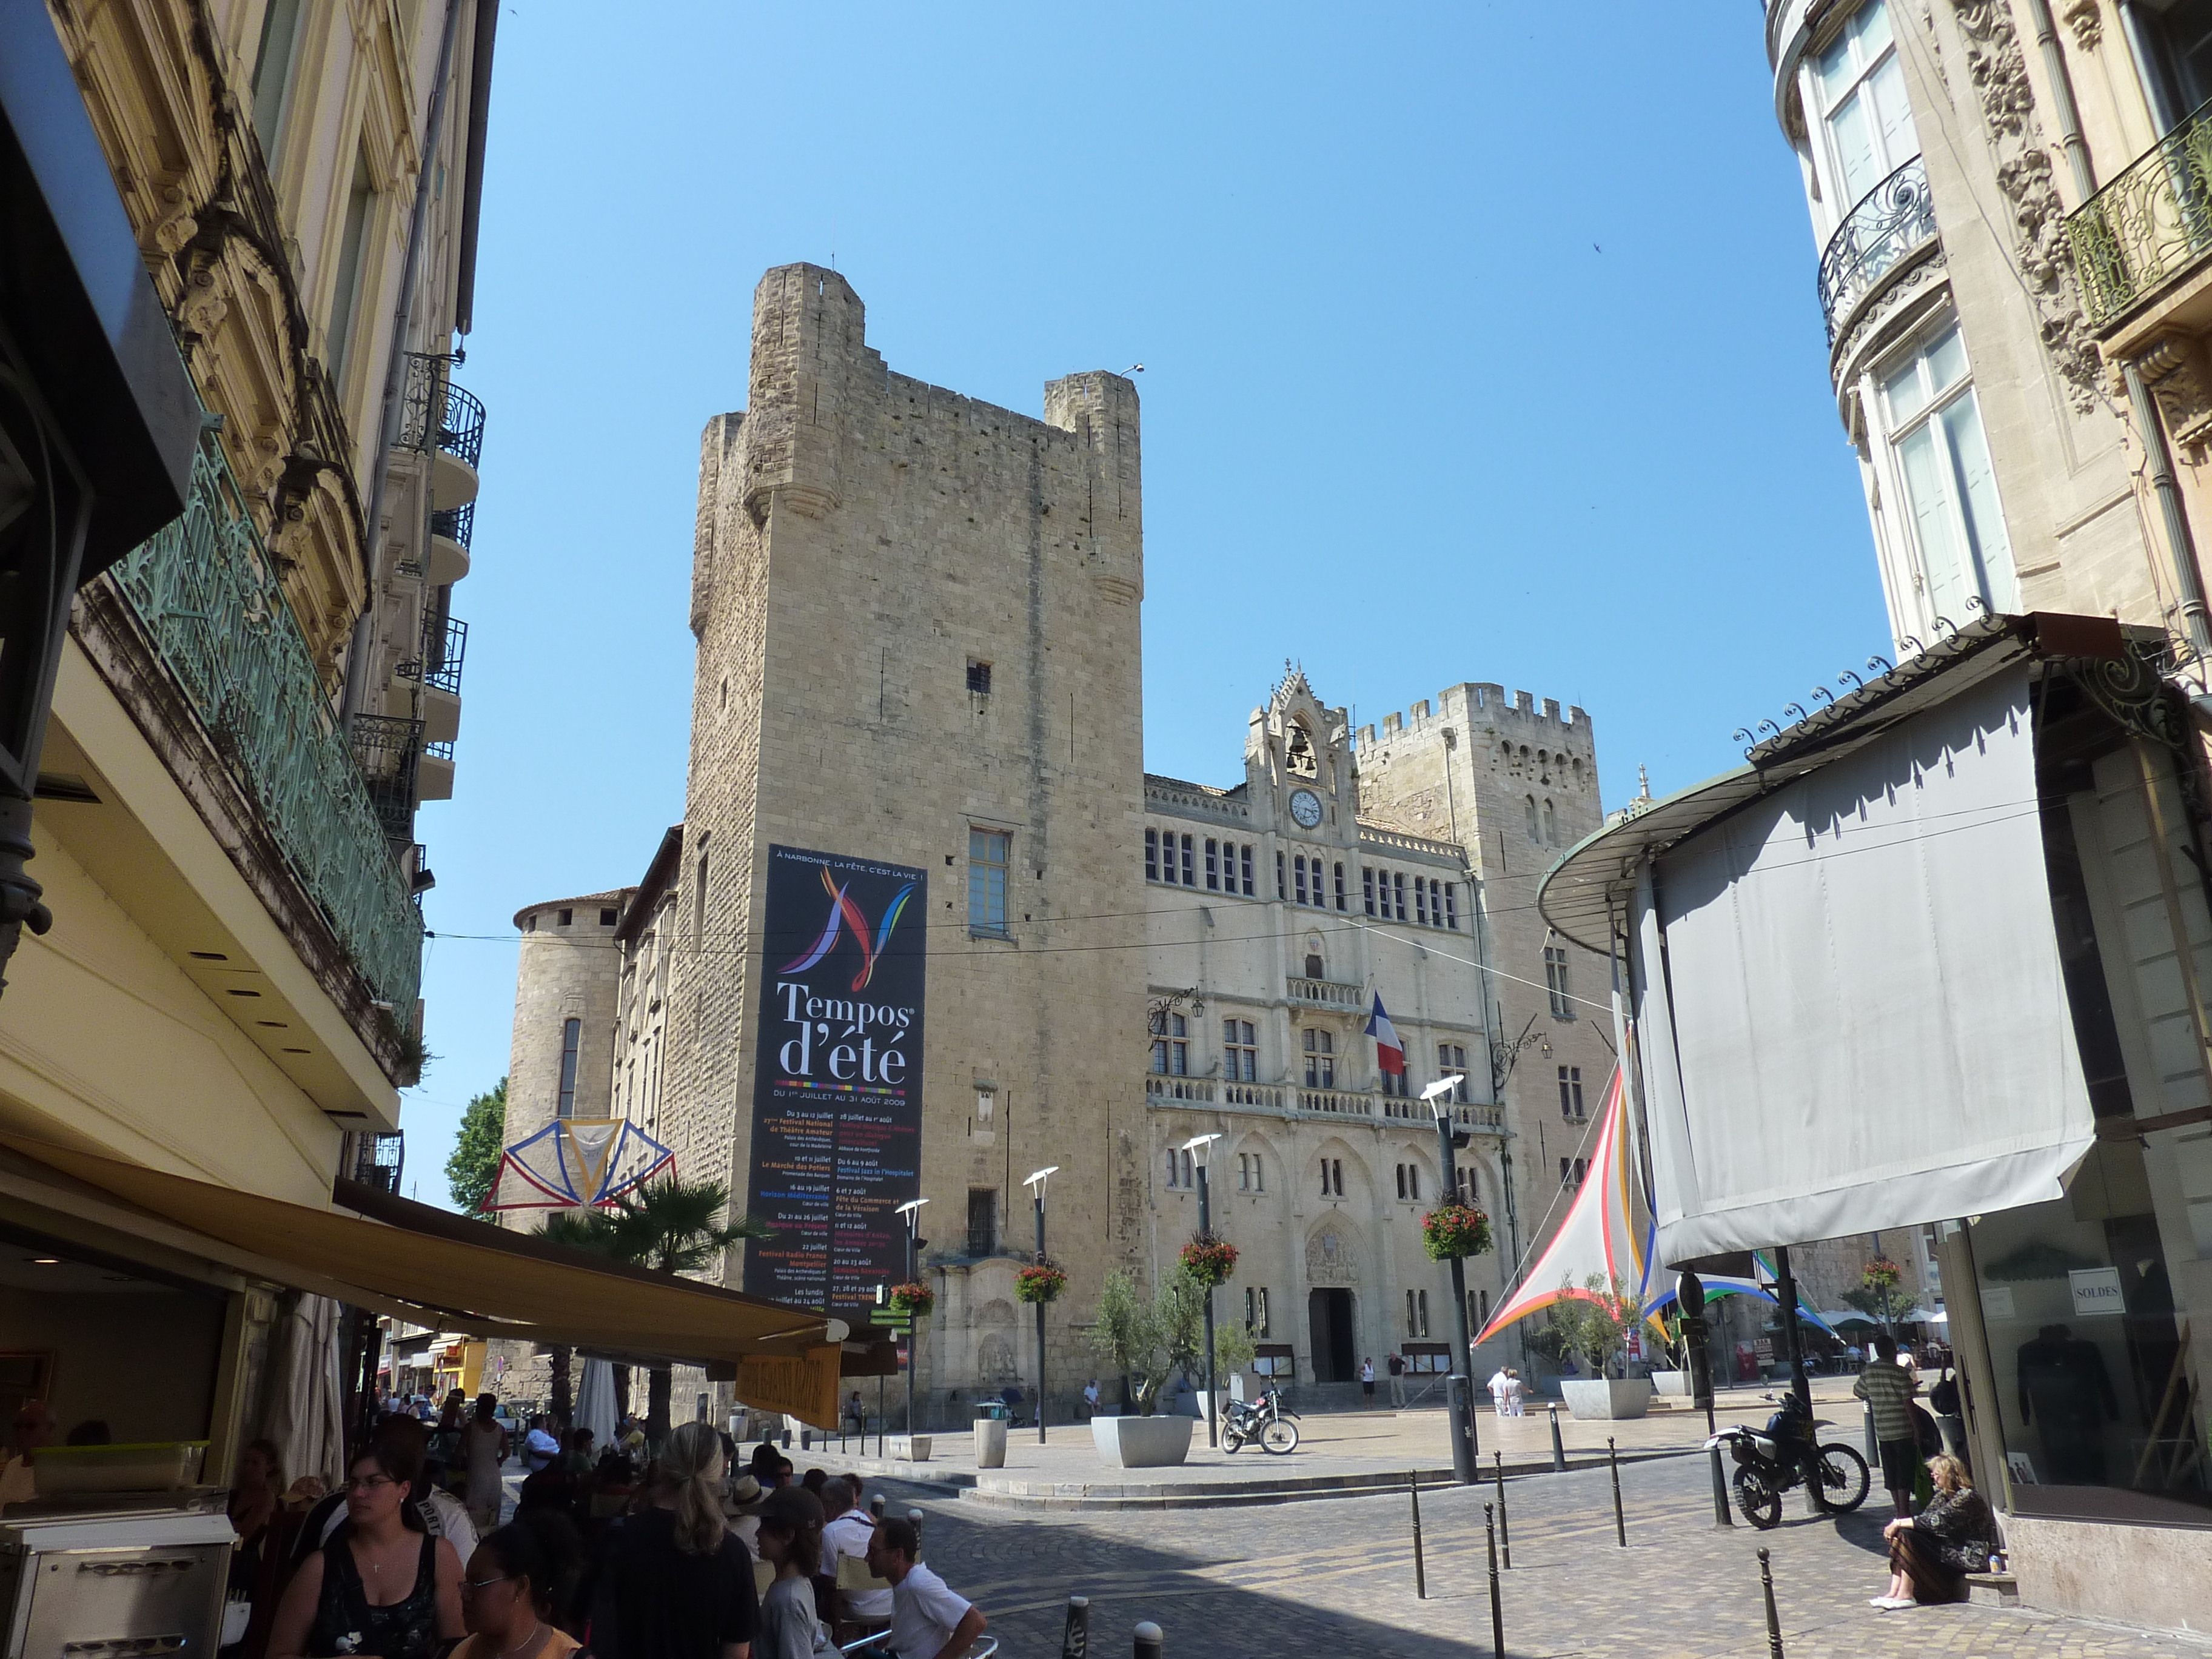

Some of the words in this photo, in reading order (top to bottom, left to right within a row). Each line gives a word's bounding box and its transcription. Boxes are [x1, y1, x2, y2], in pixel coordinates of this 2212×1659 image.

[869, 866, 890, 876] C'EST
[780, 1021, 906, 1084] d'été
[800, 1092, 833, 1101] JUILLET
[860, 1095, 881, 1104] AOÛT
[816, 1111, 833, 1120] juillet
[806, 1119, 833, 1128] National
[853, 1204, 879, 1213] Véraison
[811, 1214, 829, 1222] juillet
[810, 1243, 827, 1252] juillet
[789, 1260, 826, 1269] Montpellier
[2077, 1286, 2117, 1299] SOLDES
[418, 1501, 441, 1530] PORT
